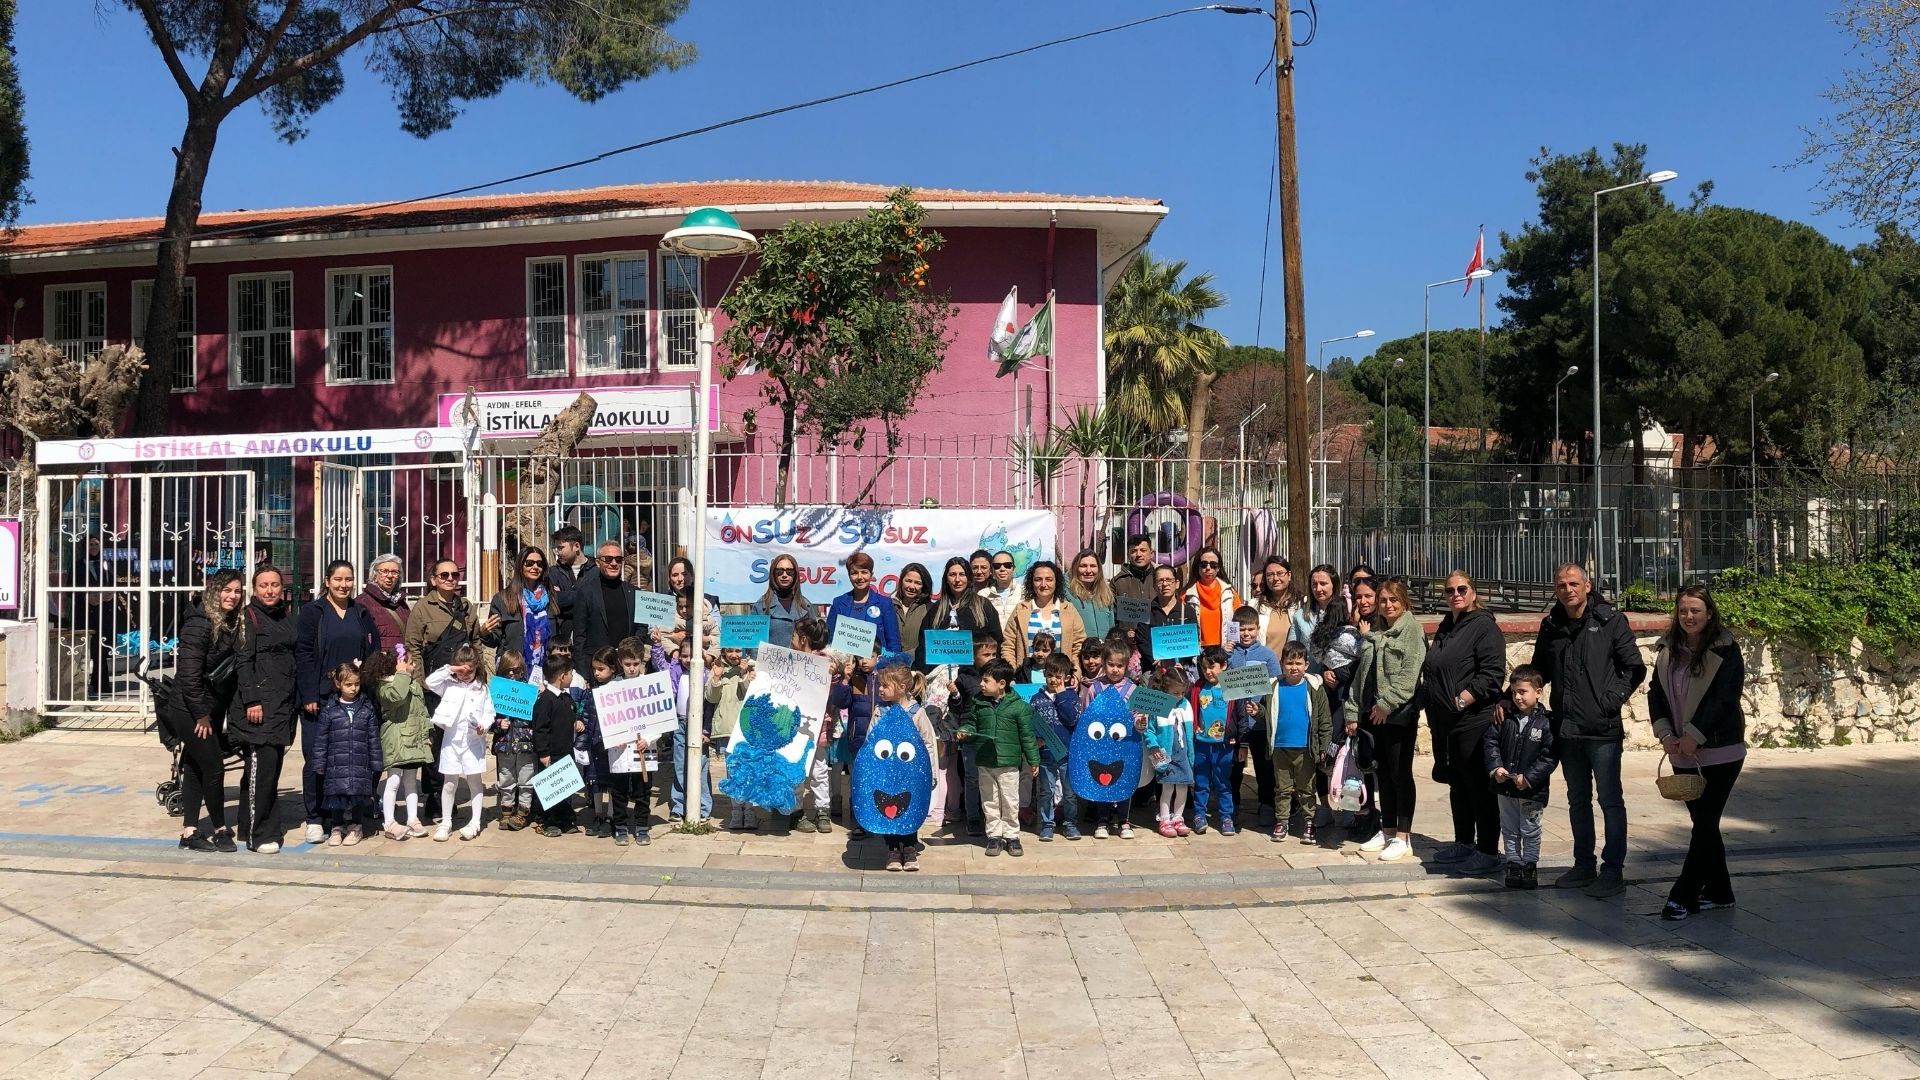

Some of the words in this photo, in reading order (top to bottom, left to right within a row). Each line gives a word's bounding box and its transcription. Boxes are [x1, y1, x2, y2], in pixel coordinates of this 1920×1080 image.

[487, 401, 510, 409] AYDIN
[515, 400, 542, 408] EFELER
[486, 411, 557, 431] İSTİKLA
[588, 410, 670, 427] AOKULU
[135, 439, 236, 458] İSTİKLAL
[244, 436, 372, 454] ANAOKULU
[749, 558, 836, 584] SSUZ
[600, 682, 665, 708] İSTİKLAL
